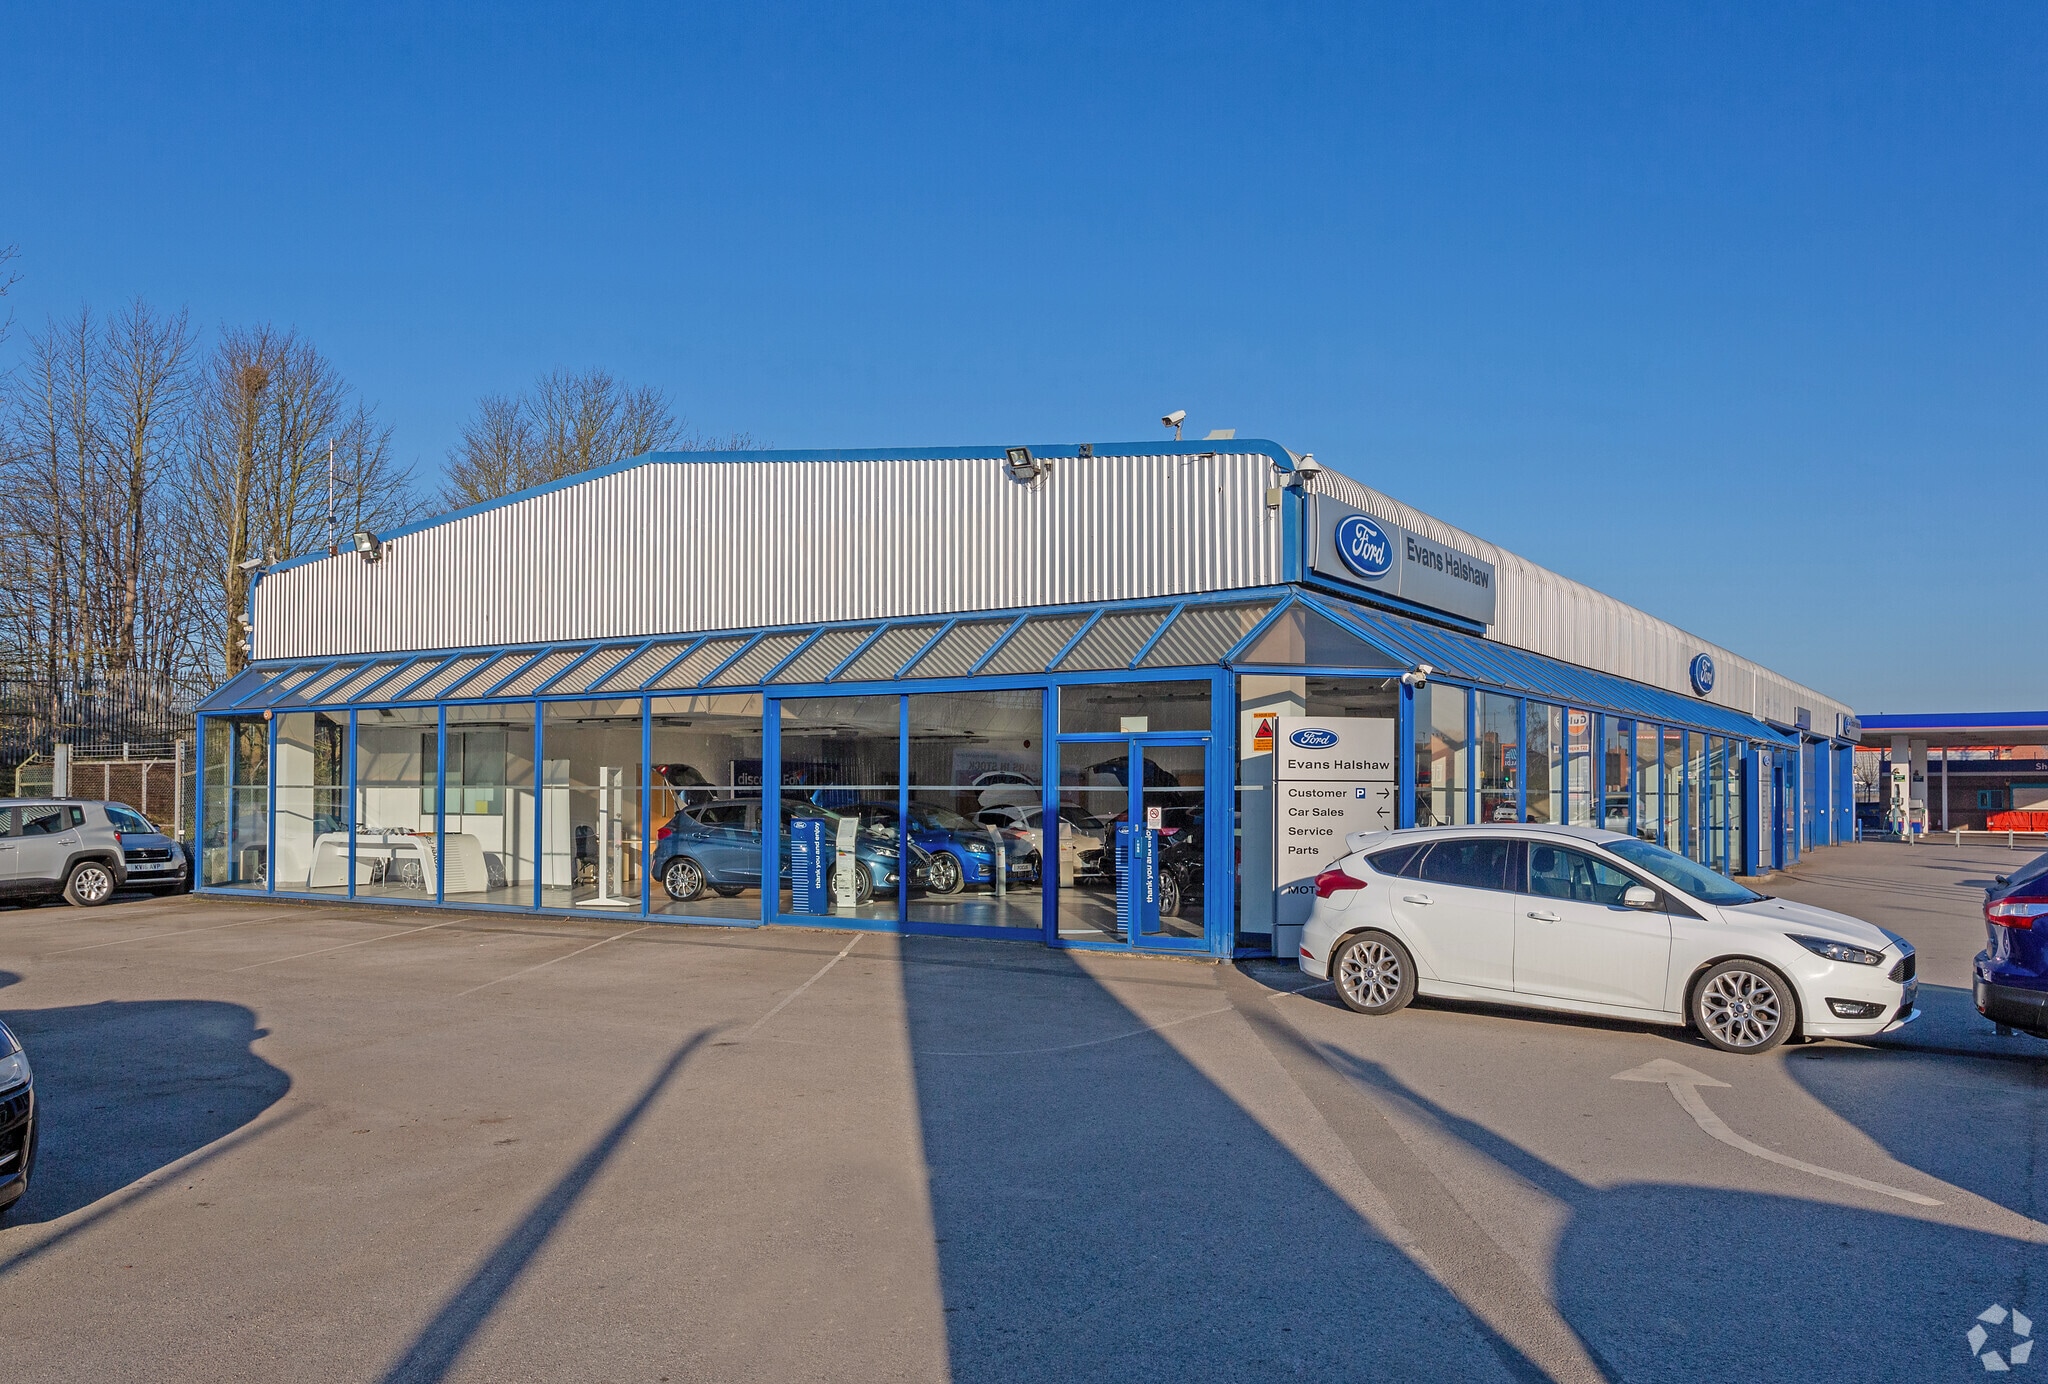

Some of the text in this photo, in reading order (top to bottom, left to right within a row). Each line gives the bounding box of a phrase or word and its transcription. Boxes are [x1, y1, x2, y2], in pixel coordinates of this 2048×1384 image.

[1352, 523, 1385, 566] Ford
[1406, 536, 1489, 589] Evans Halshaw
[1300, 731, 1331, 745] Ford
[1288, 759, 1390, 770] Evans Halshaw
[738, 772, 763, 785] disc
[1288, 788, 1365, 798] Customer P
[1288, 807, 1344, 817] Car Sales
[1288, 826, 1333, 836] Service
[1288, 846, 1319, 855] Parts
[1288, 885, 1315, 895] MOT
